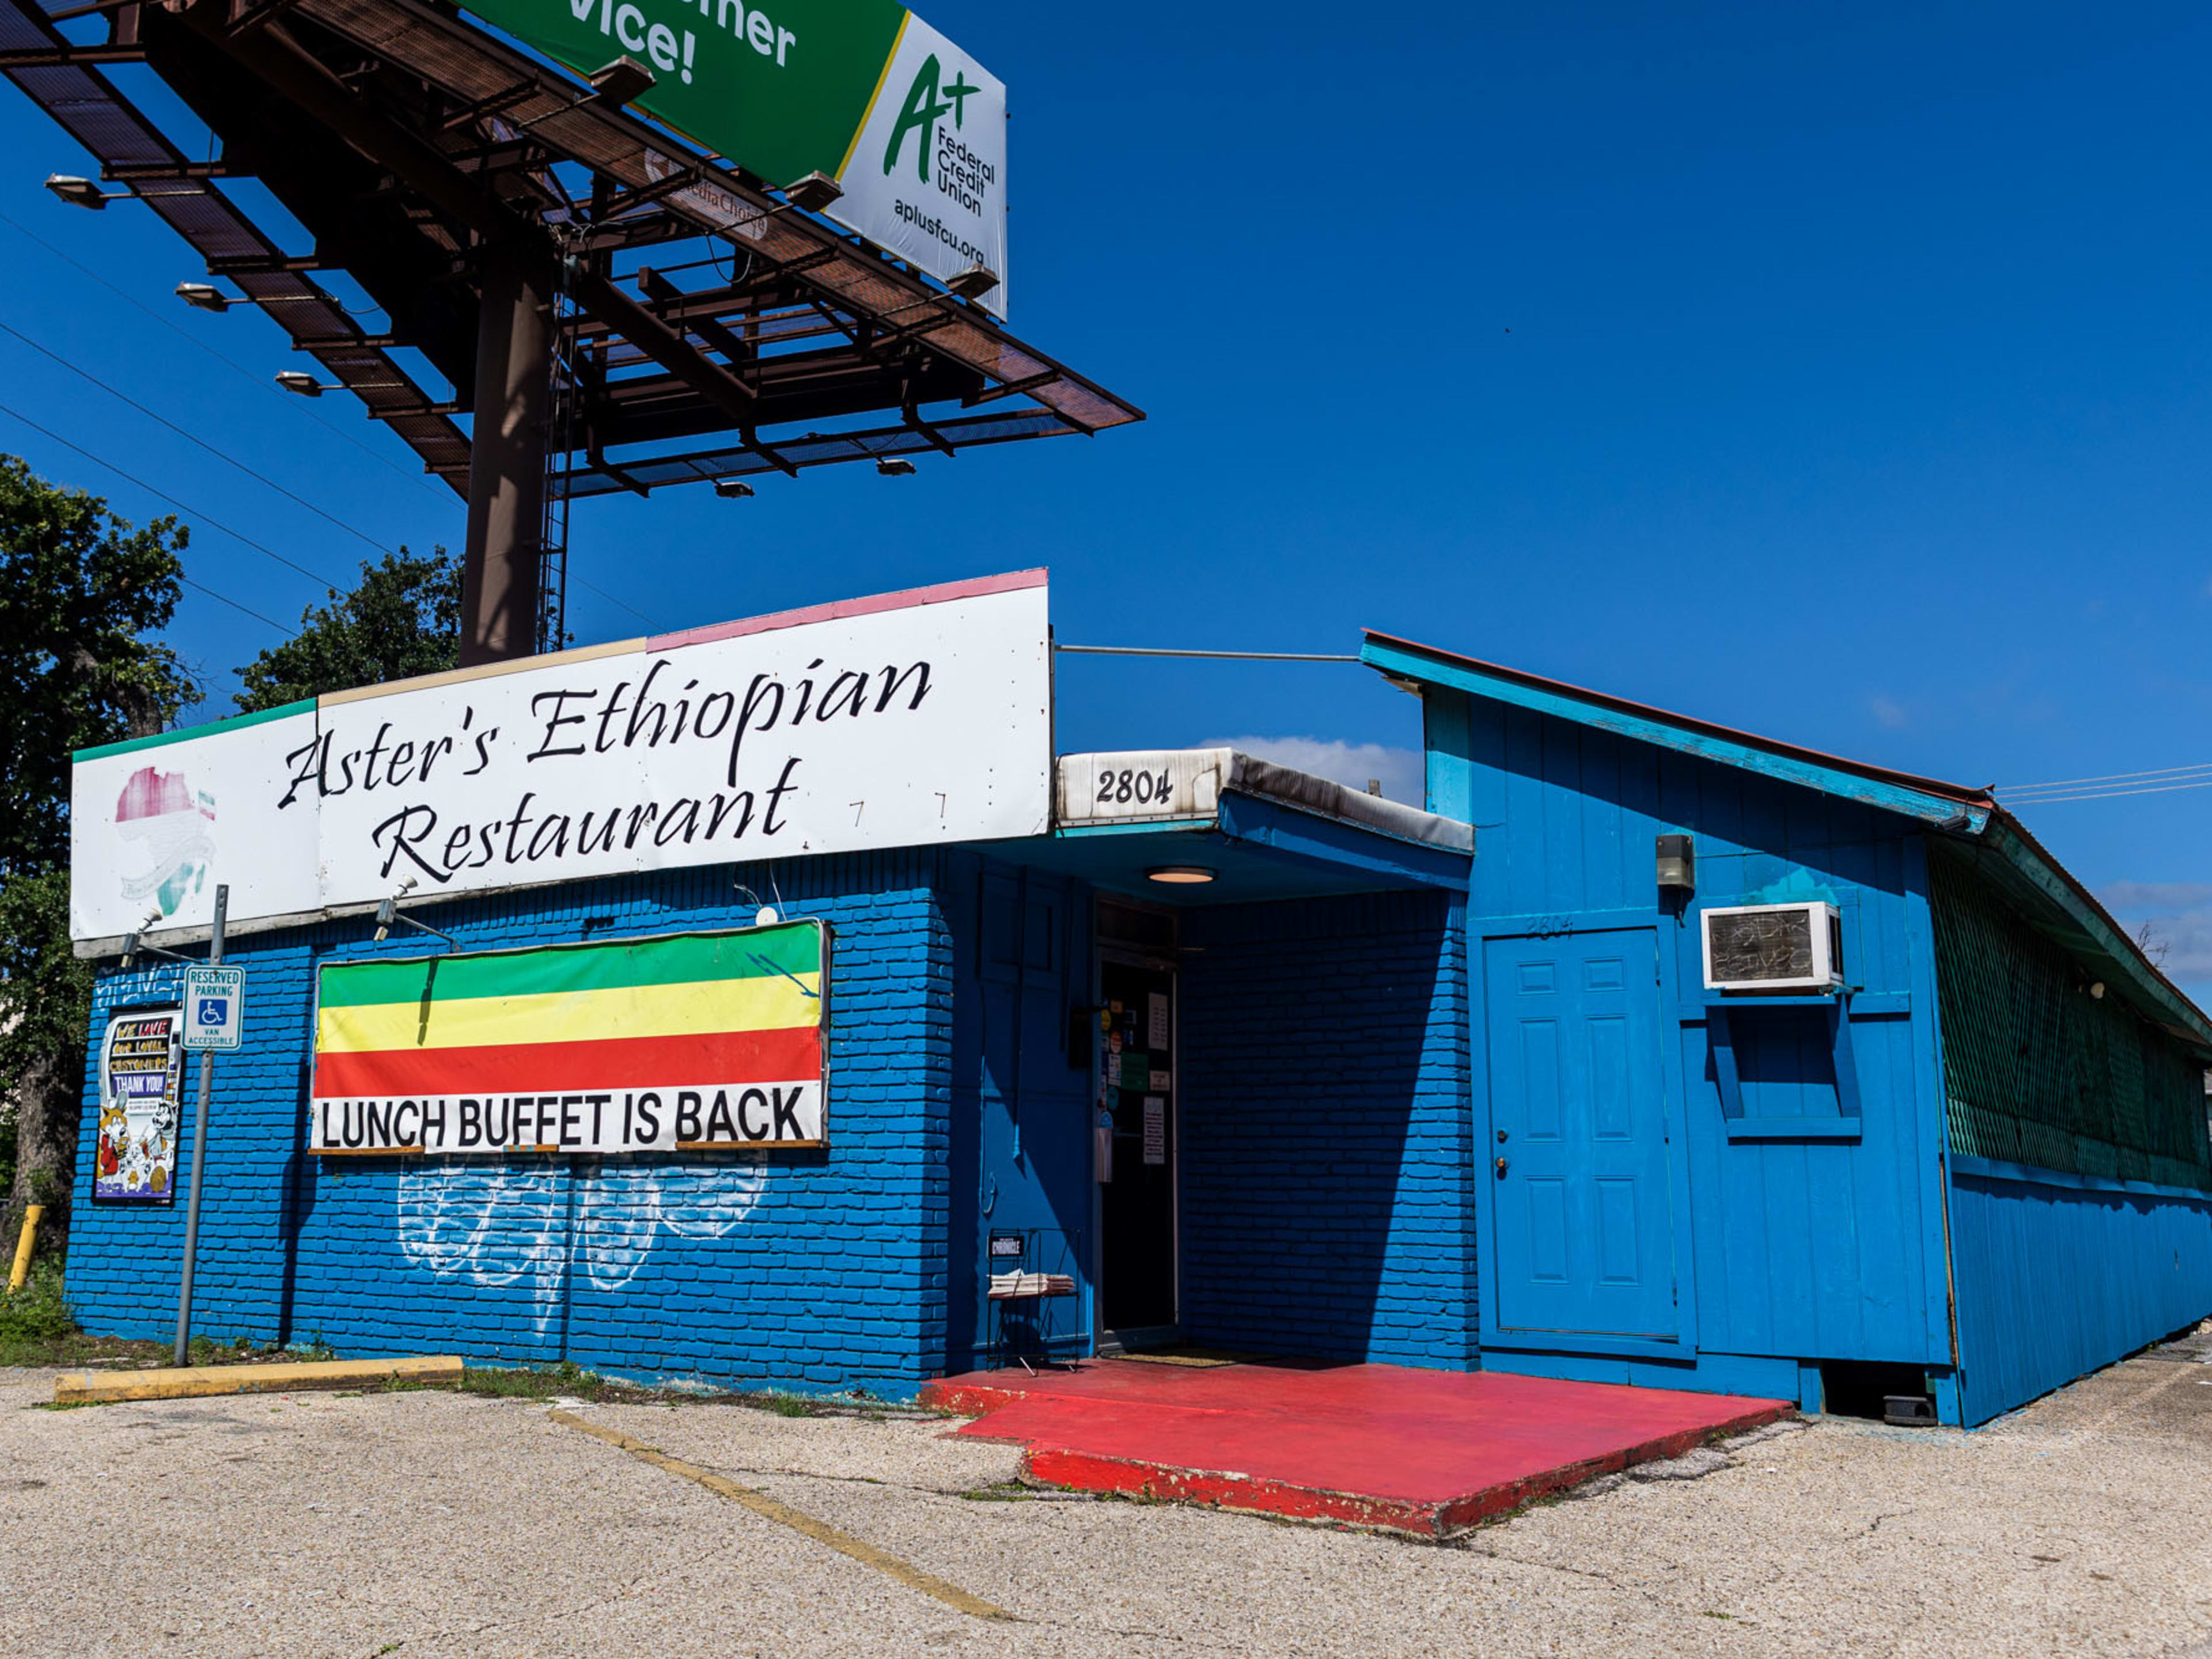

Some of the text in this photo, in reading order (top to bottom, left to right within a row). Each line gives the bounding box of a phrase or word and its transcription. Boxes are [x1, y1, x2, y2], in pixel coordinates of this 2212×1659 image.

[883, 52, 981, 184] A+
[937, 149, 986, 198] Credit
[938, 125, 994, 184] Federal
[937, 169, 982, 217] Union
[278, 660, 931, 809] Aster's Ethiopian
[1096, 767, 1173, 805] 2804
[372, 757, 803, 884] Restaurant
[190, 971, 239, 984] RESERVED
[195, 986, 233, 997] PARKING
[110, 1058, 167, 1071] CUSTOMERS
[188, 1037, 233, 1045] ACCESSIBLE
[115, 1075, 164, 1093] THANK YOU!
[322, 1086, 804, 1147] LUNCH BUFFET IS BACK
